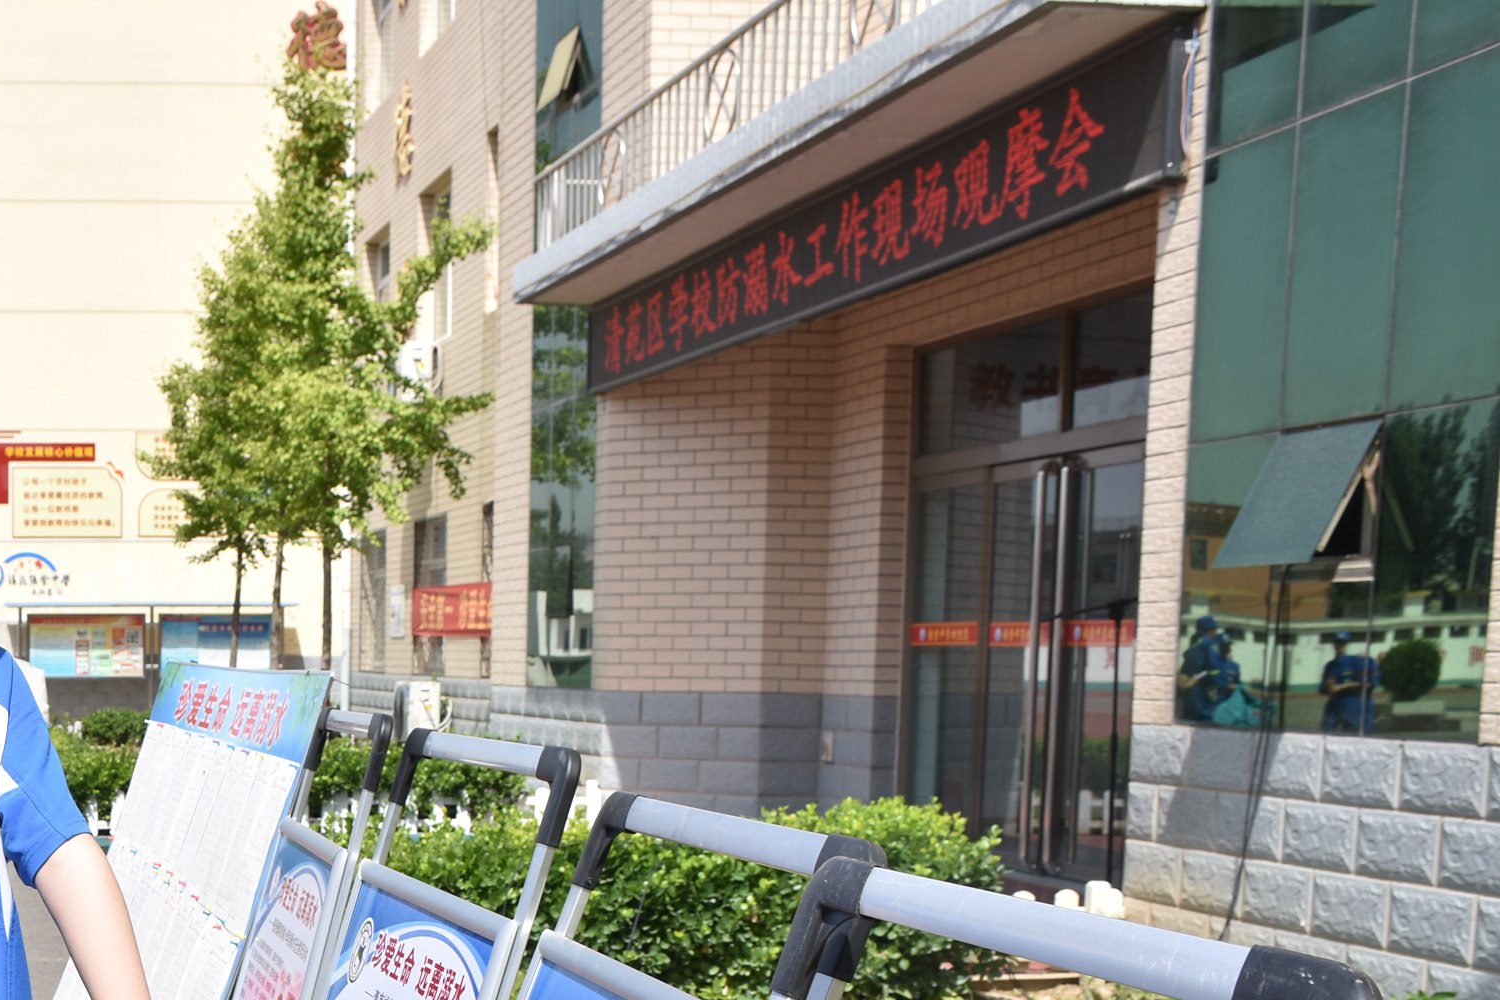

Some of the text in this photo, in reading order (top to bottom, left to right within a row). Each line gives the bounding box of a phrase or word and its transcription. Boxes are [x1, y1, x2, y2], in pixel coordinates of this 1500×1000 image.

[603, 87, 1105, 375] 清苑区学校防溺水工作现场观摩会
[5, 446, 93, 458] 学校发展核心价值观
[459, 589, 491, 629] 珍爱生
[173, 678, 290, 748] 珍爱生命 远离溺水
[371, 934, 414, 986] 珍爱生命
